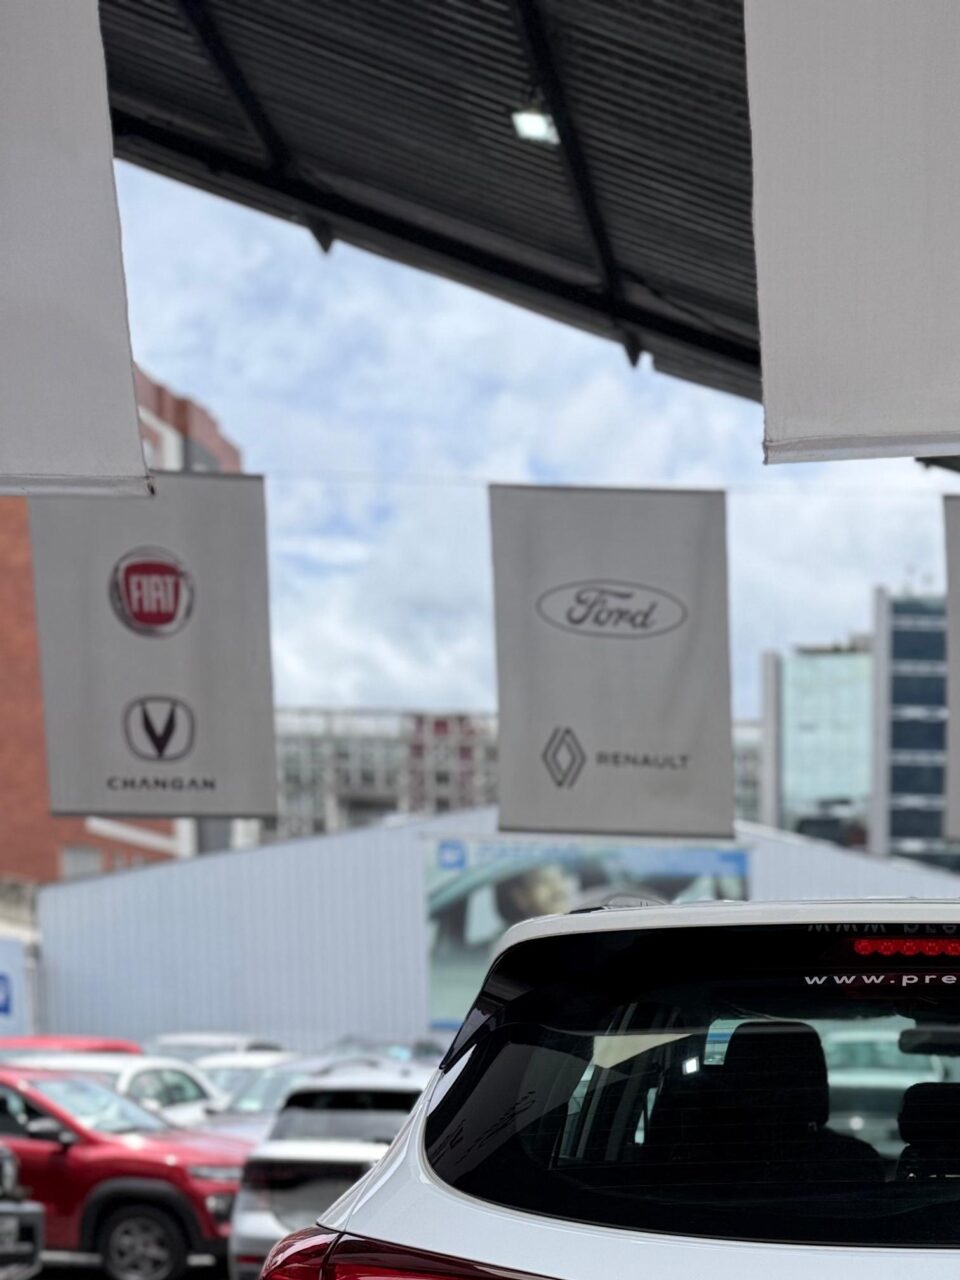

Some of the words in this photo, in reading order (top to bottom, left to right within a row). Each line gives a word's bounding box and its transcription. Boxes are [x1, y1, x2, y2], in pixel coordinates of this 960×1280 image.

[128, 573, 178, 614] FIAT
[565, 586, 658, 629] Ford
[595, 751, 690, 769] RENAULT
[106, 775, 217, 792] CHANGAN
